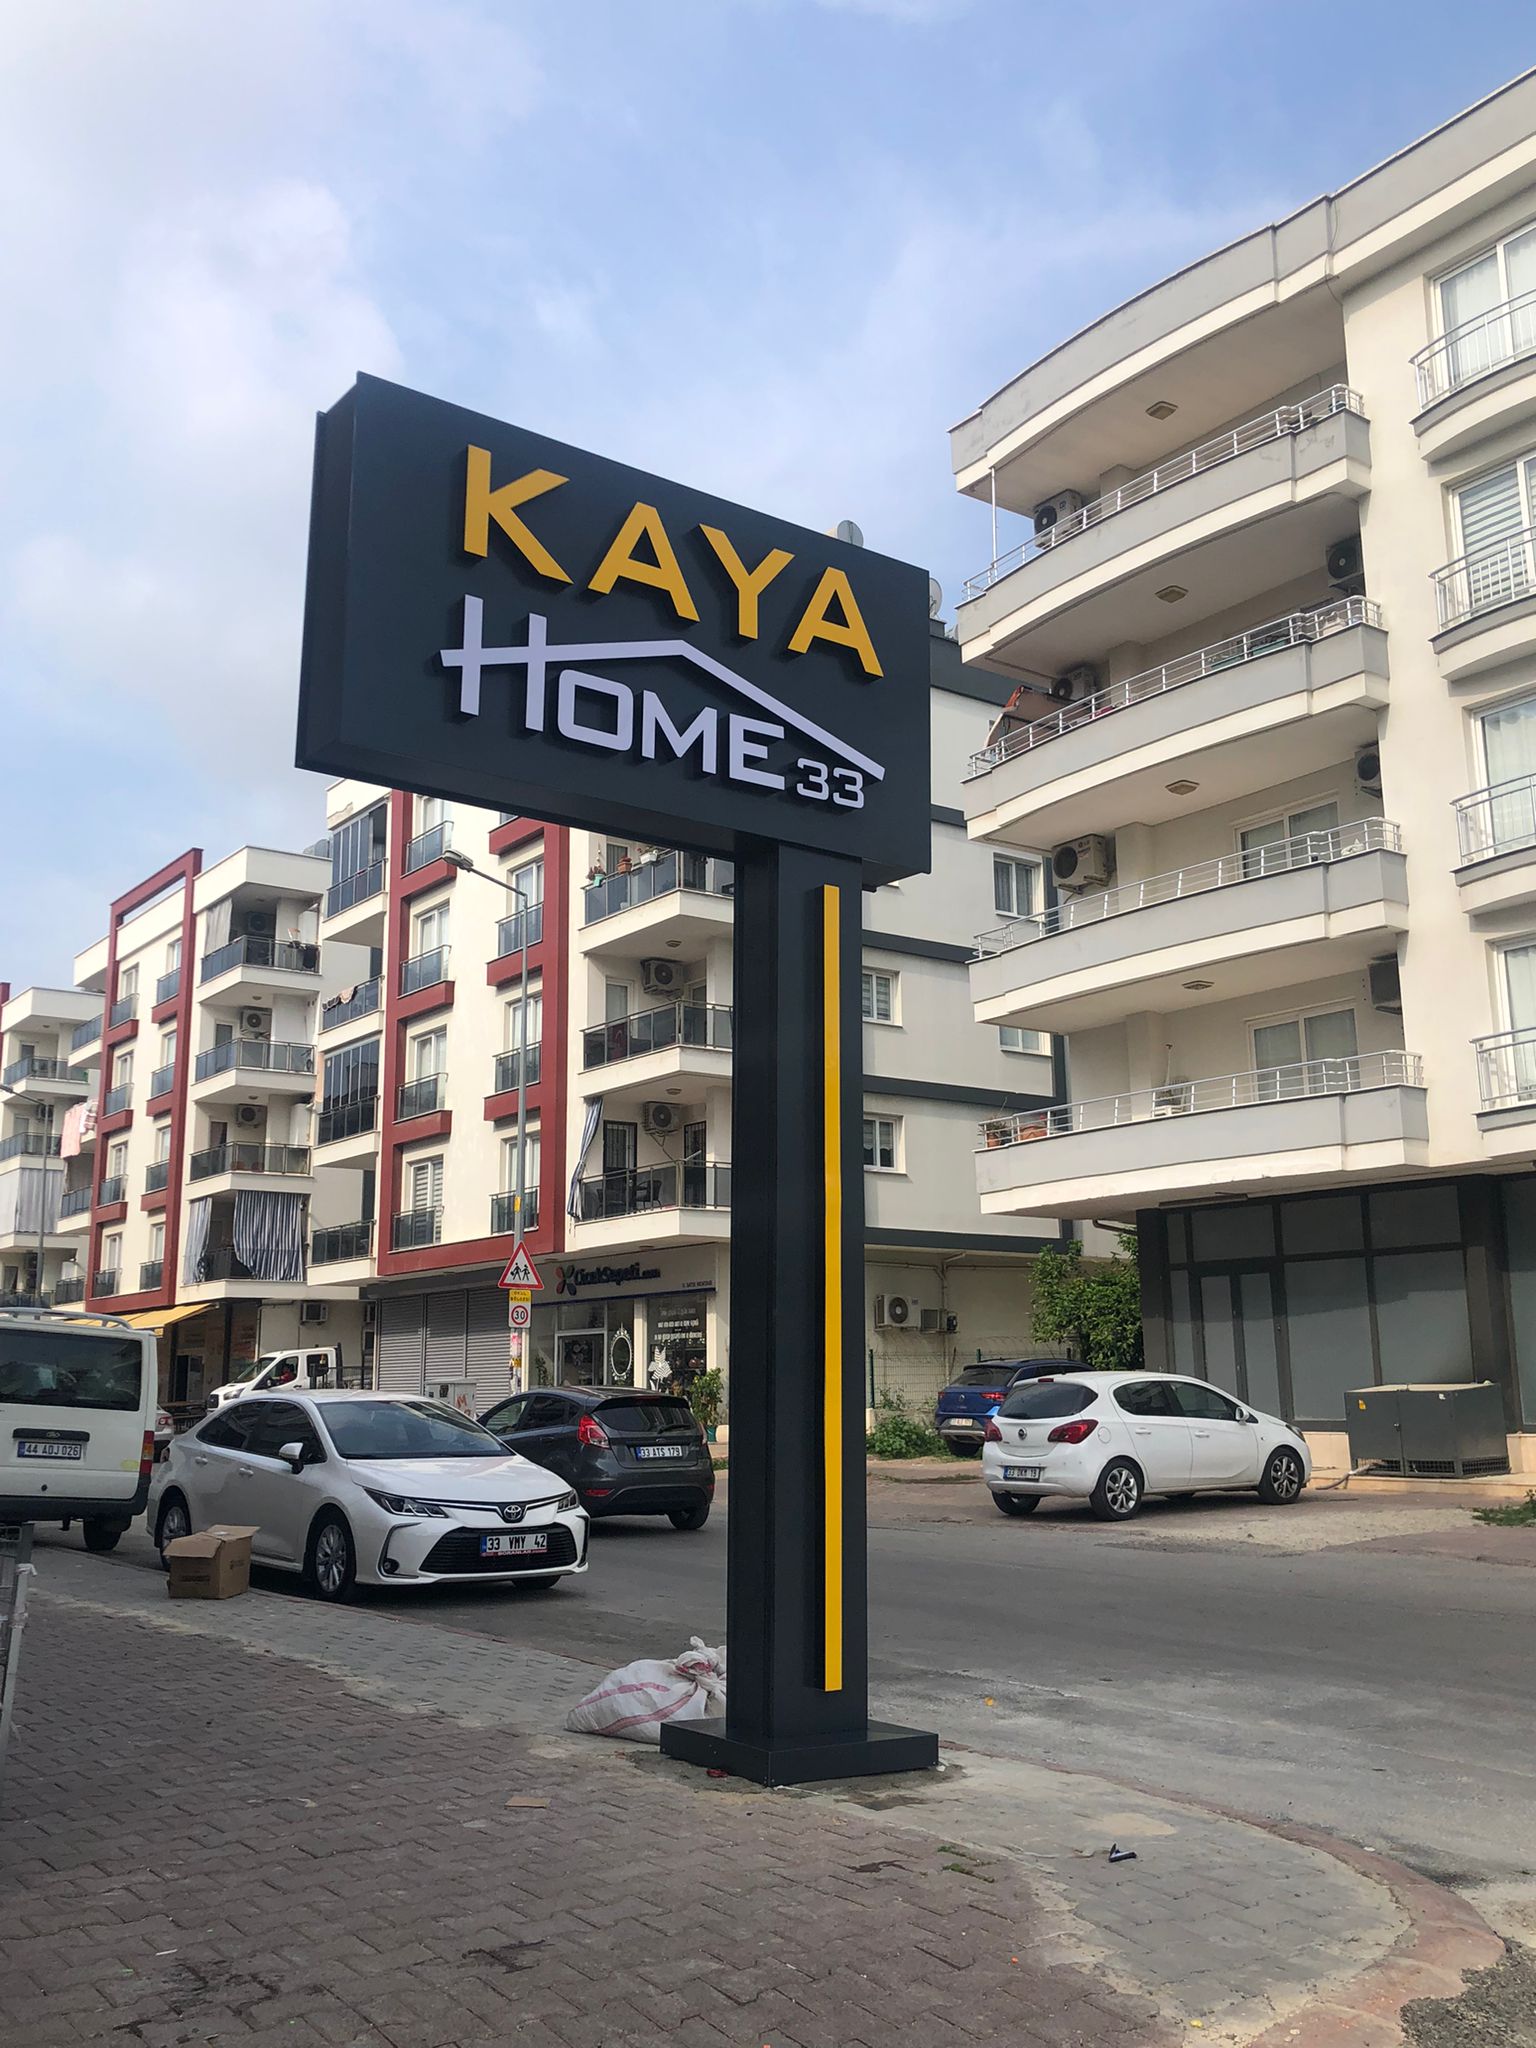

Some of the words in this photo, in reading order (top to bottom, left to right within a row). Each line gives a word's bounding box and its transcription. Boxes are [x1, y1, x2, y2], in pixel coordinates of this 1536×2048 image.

[463, 443, 885, 679] KAYA
[440, 593, 786, 791] HOME
[796, 757, 866, 809] 33
[514, 1310, 526, 1320] 30
[26, 1444, 38, 1454] 44
[62, 1445, 79, 1456] 026
[641, 1448, 650, 1457] 33
[487, 1537, 500, 1551] 33
[509, 1536, 526, 1550] VMY
[534, 1534, 546, 1548] 42
